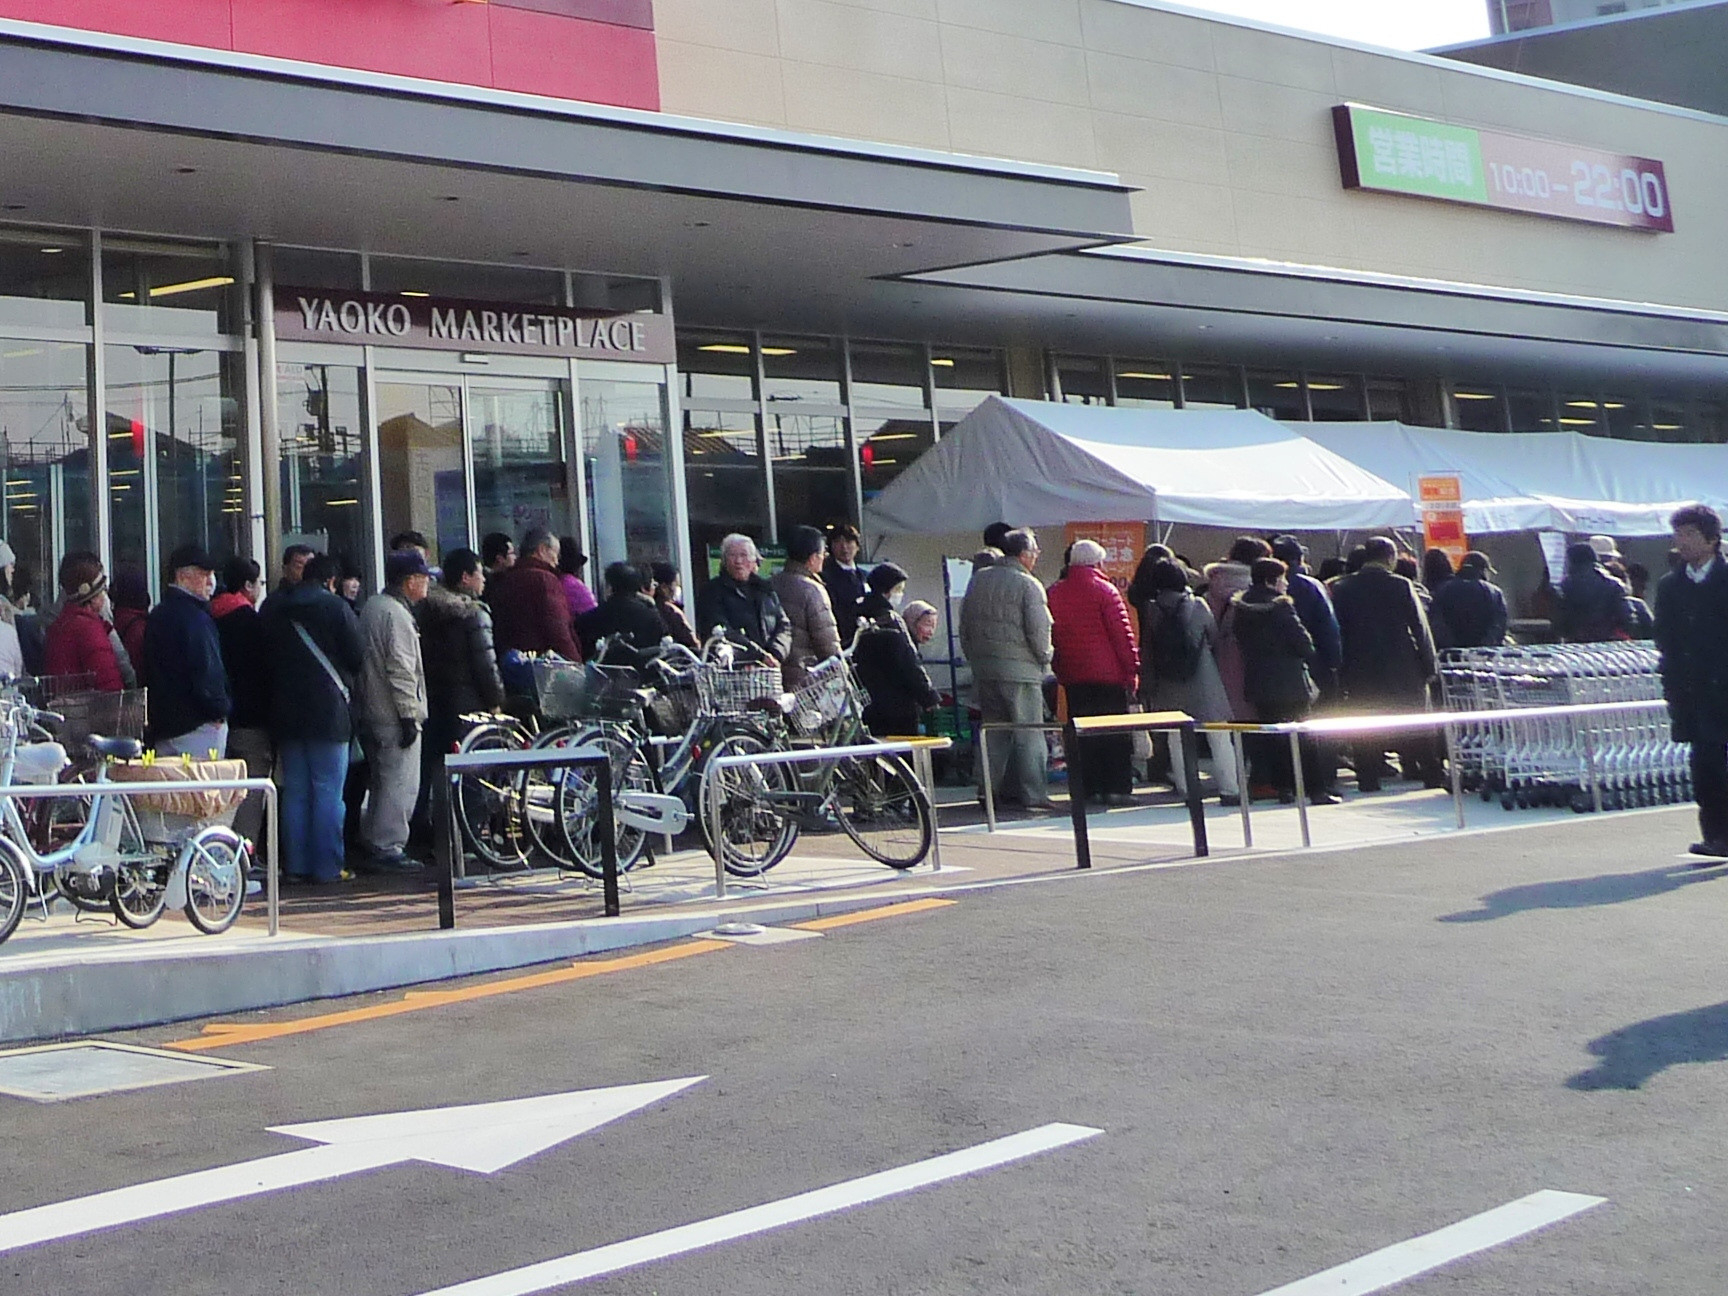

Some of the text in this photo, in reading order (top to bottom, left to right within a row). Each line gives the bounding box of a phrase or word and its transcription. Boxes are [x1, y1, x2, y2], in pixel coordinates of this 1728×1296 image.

[1368, 126, 1473, 186] 営業時間
[298, 296, 647, 352] YAOKO MARKETPLACE
